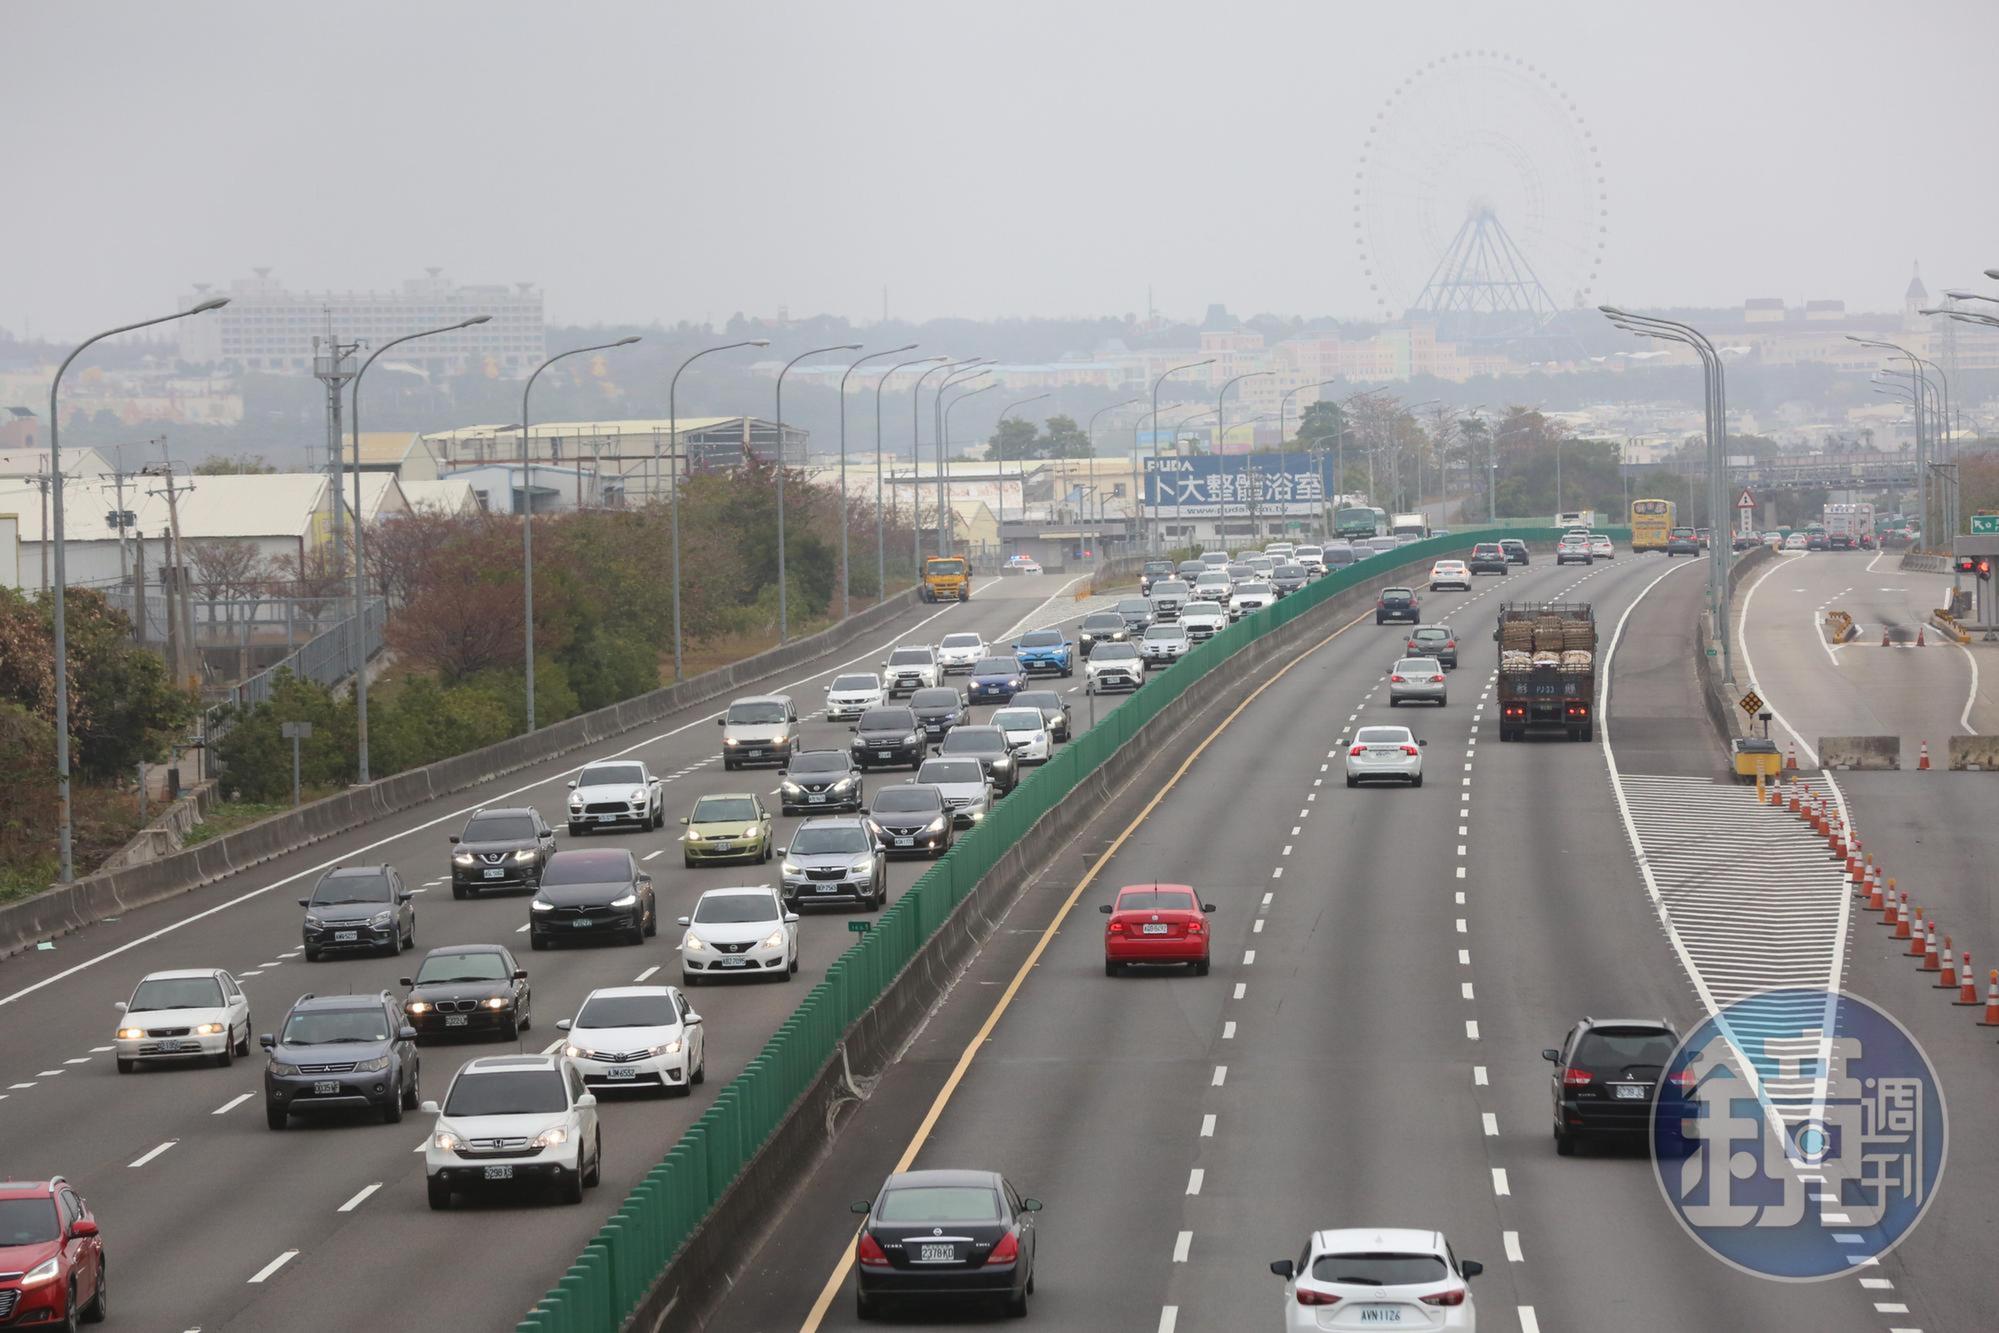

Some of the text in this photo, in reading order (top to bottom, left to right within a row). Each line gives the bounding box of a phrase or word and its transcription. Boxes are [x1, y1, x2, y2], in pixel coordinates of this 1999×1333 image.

[1147, 460, 1194, 473] PUDA
[1156, 472, 1323, 502] 卜大整體浴室
[1187, 505, 1289, 515] www.puda.om.tw
